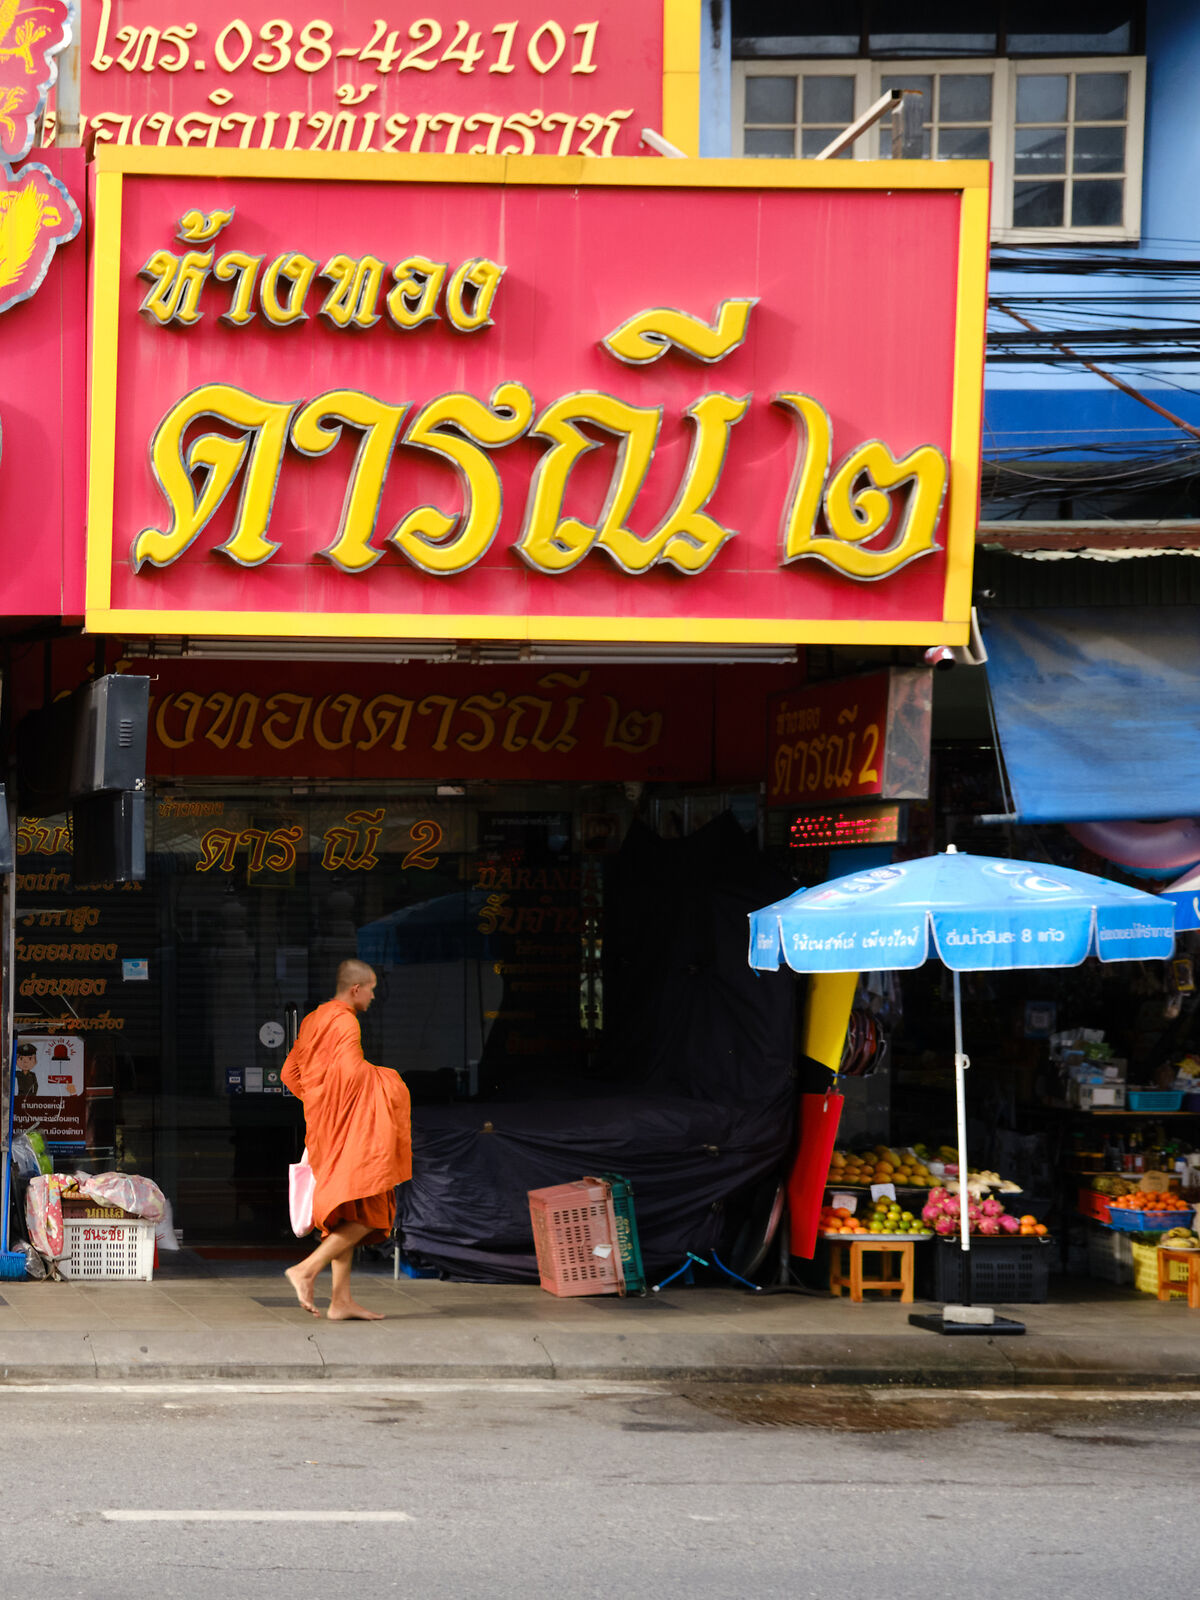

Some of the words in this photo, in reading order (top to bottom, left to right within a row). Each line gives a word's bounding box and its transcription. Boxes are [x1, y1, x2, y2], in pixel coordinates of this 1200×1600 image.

[137, 206, 507, 332] ห้างทอง
[133, 297, 761, 575] ดารณี
[858, 722, 880, 785] 2
[1021, 927, 1032, 943] 8
